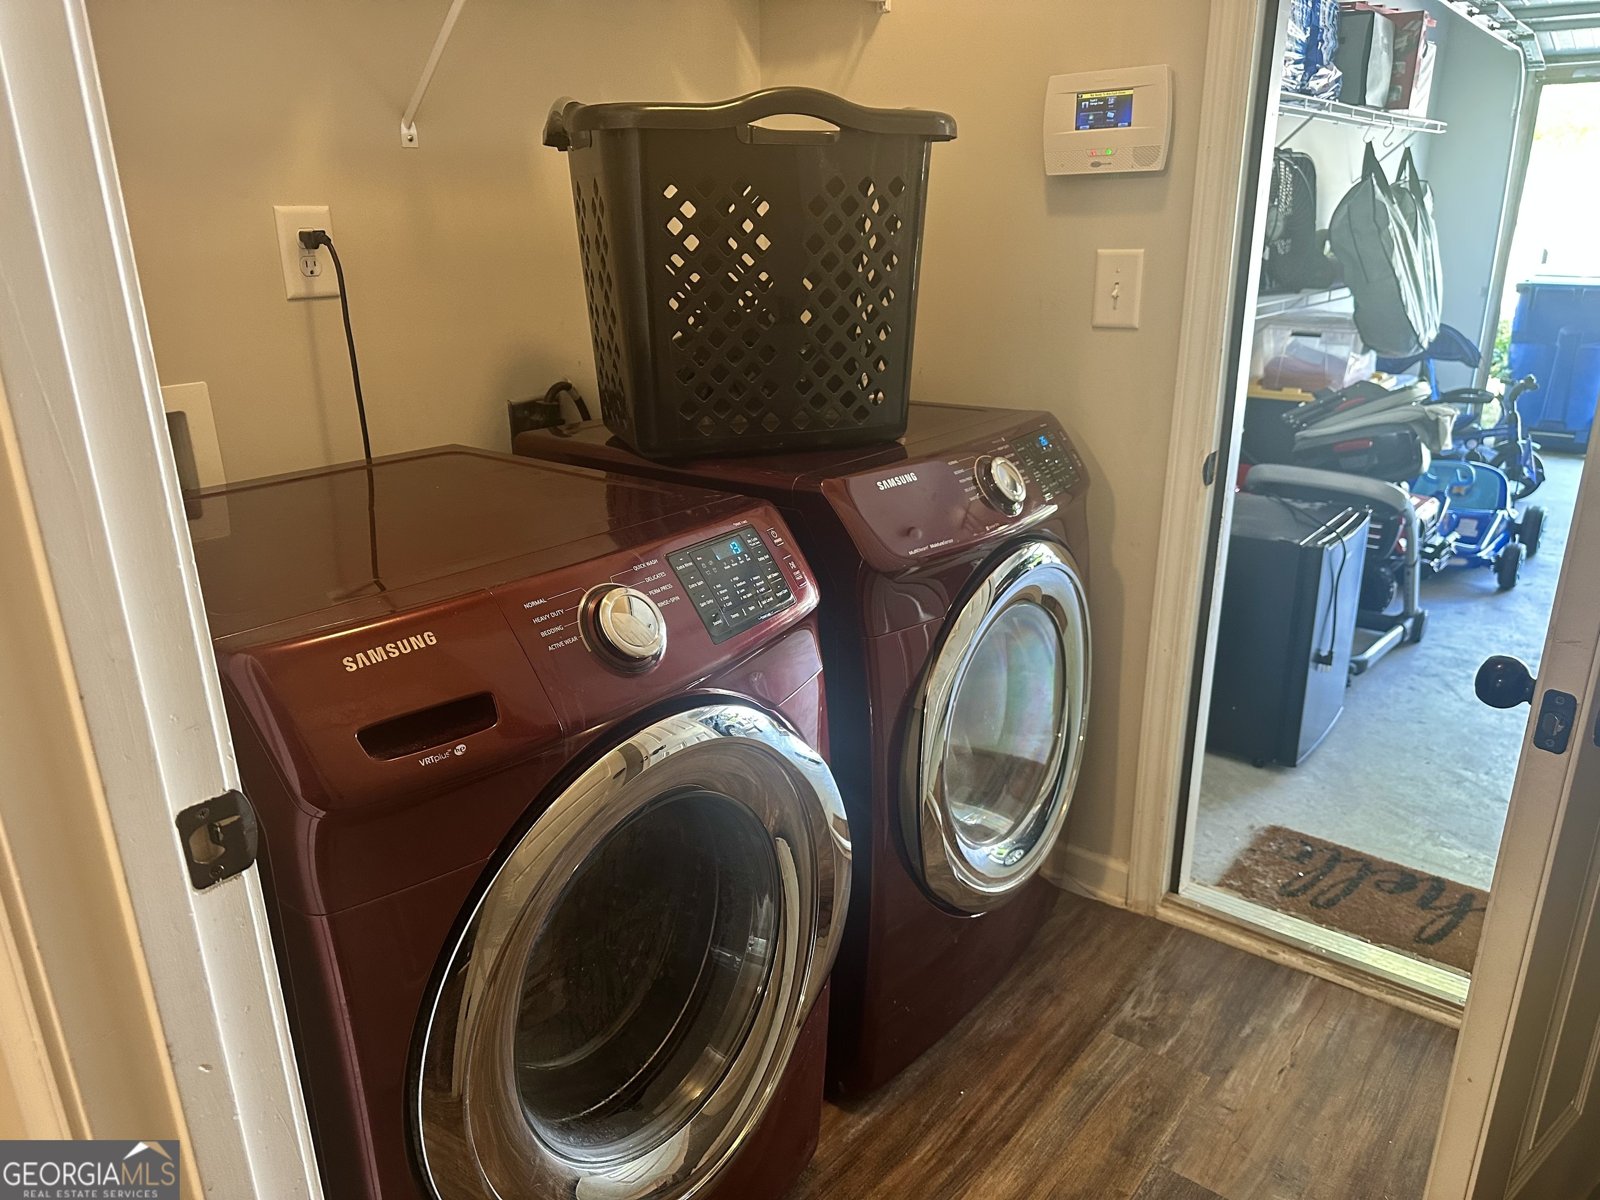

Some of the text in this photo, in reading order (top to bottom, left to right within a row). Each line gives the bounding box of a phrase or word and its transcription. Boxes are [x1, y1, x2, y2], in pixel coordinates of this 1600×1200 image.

[876, 472, 918, 491] SAMSUNG
[632, 562, 647, 571] QUICK
[644, 571, 667, 583] DELICATES
[648, 583, 673, 596] PERM PRESS
[523, 598, 547, 609] NORMAL
[532, 609, 564, 624] HEAVY DUTY
[540, 625, 564, 638] BEDDING
[548, 636, 578, 652] ACTIVE WEAR
[342, 631, 438, 672] SAMSUNG
